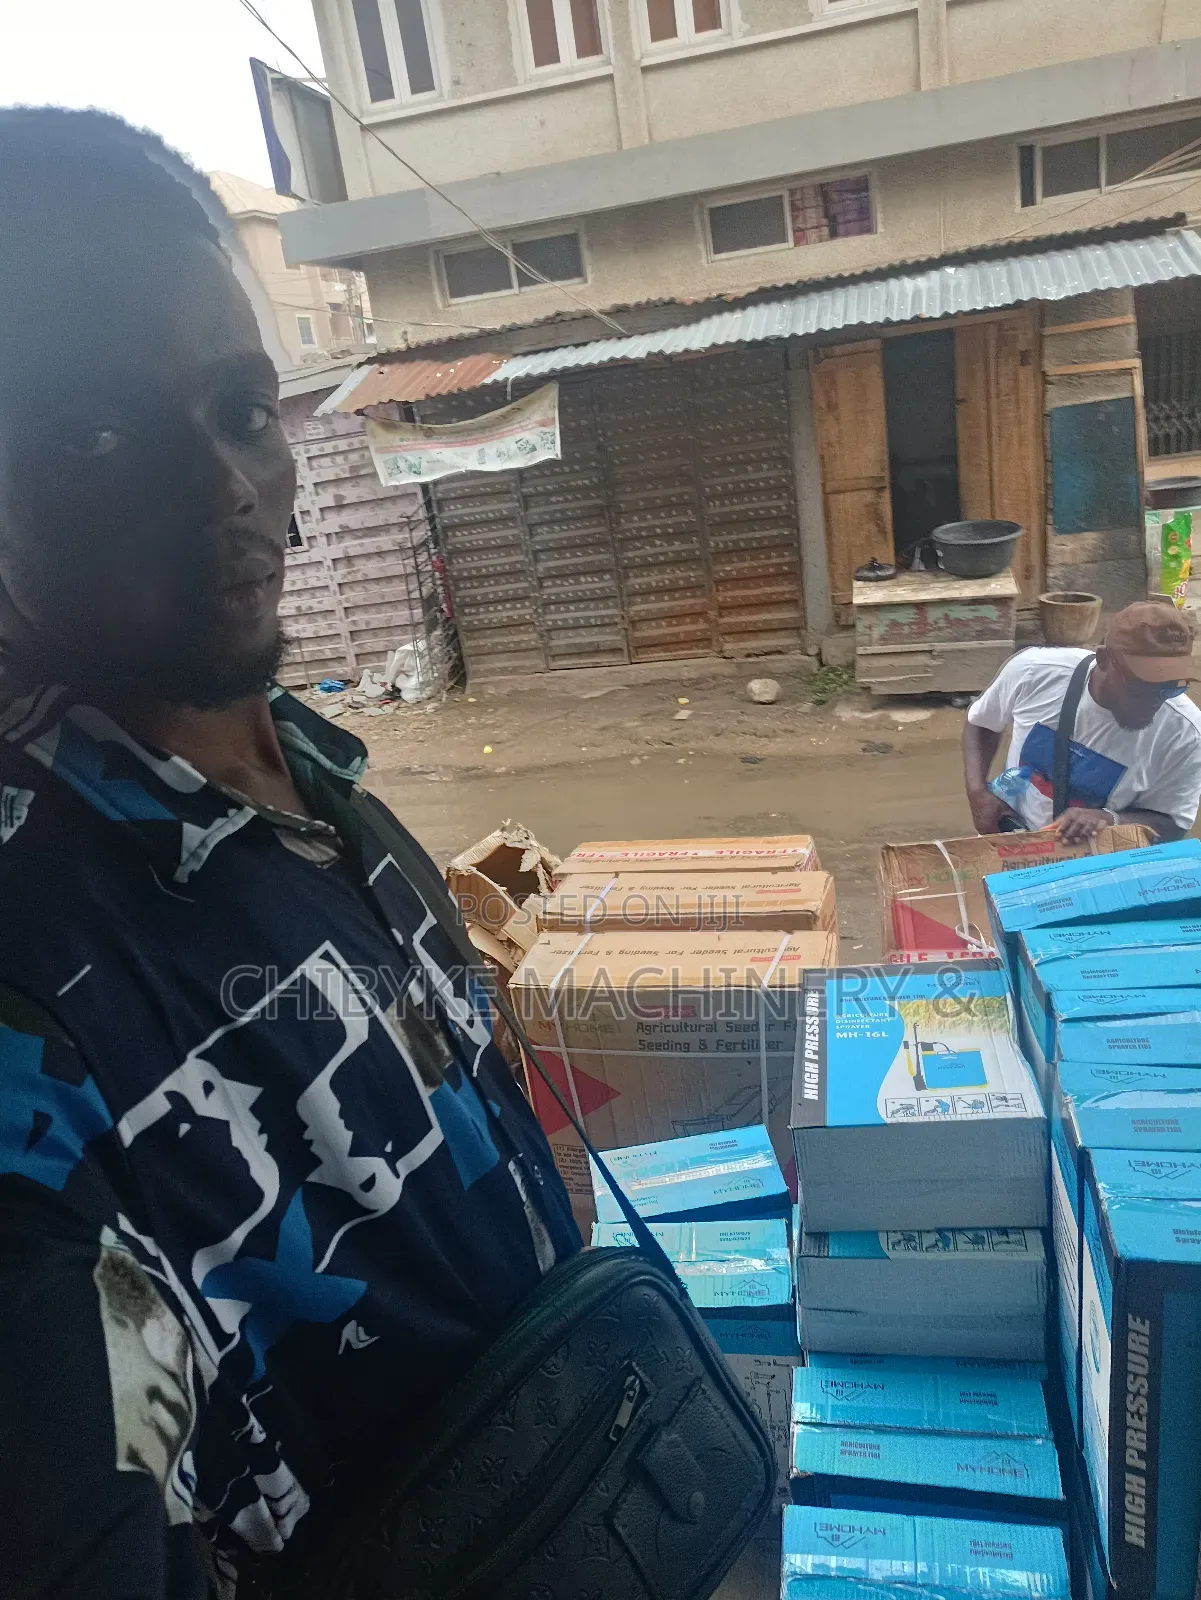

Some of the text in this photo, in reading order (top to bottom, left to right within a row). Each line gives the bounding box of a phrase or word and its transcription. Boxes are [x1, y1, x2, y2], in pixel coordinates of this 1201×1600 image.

[619, 850, 689, 858] FRAGILE
[741, 882, 801, 890] Agricultural
[1137, 881, 1197, 897] MYHOME
[618, 948, 660, 957] Seeding
[636, 1021, 718, 1035] Agricultural
[836, 1031, 889, 1039] MH-16L
[638, 1039, 691, 1053] Seeding
[698, 1038, 708, 1051] &
[802, 989, 820, 1101] HIGH PRESSURE
[1095, 1068, 1166, 1079] MYHOME
[823, 1379, 885, 1391] MYHOME
[1124, 1313, 1151, 1549] HIGH PRESSURE
[956, 1462, 1025, 1479] MYHOME
[818, 1522, 887, 1537] MYHOME
